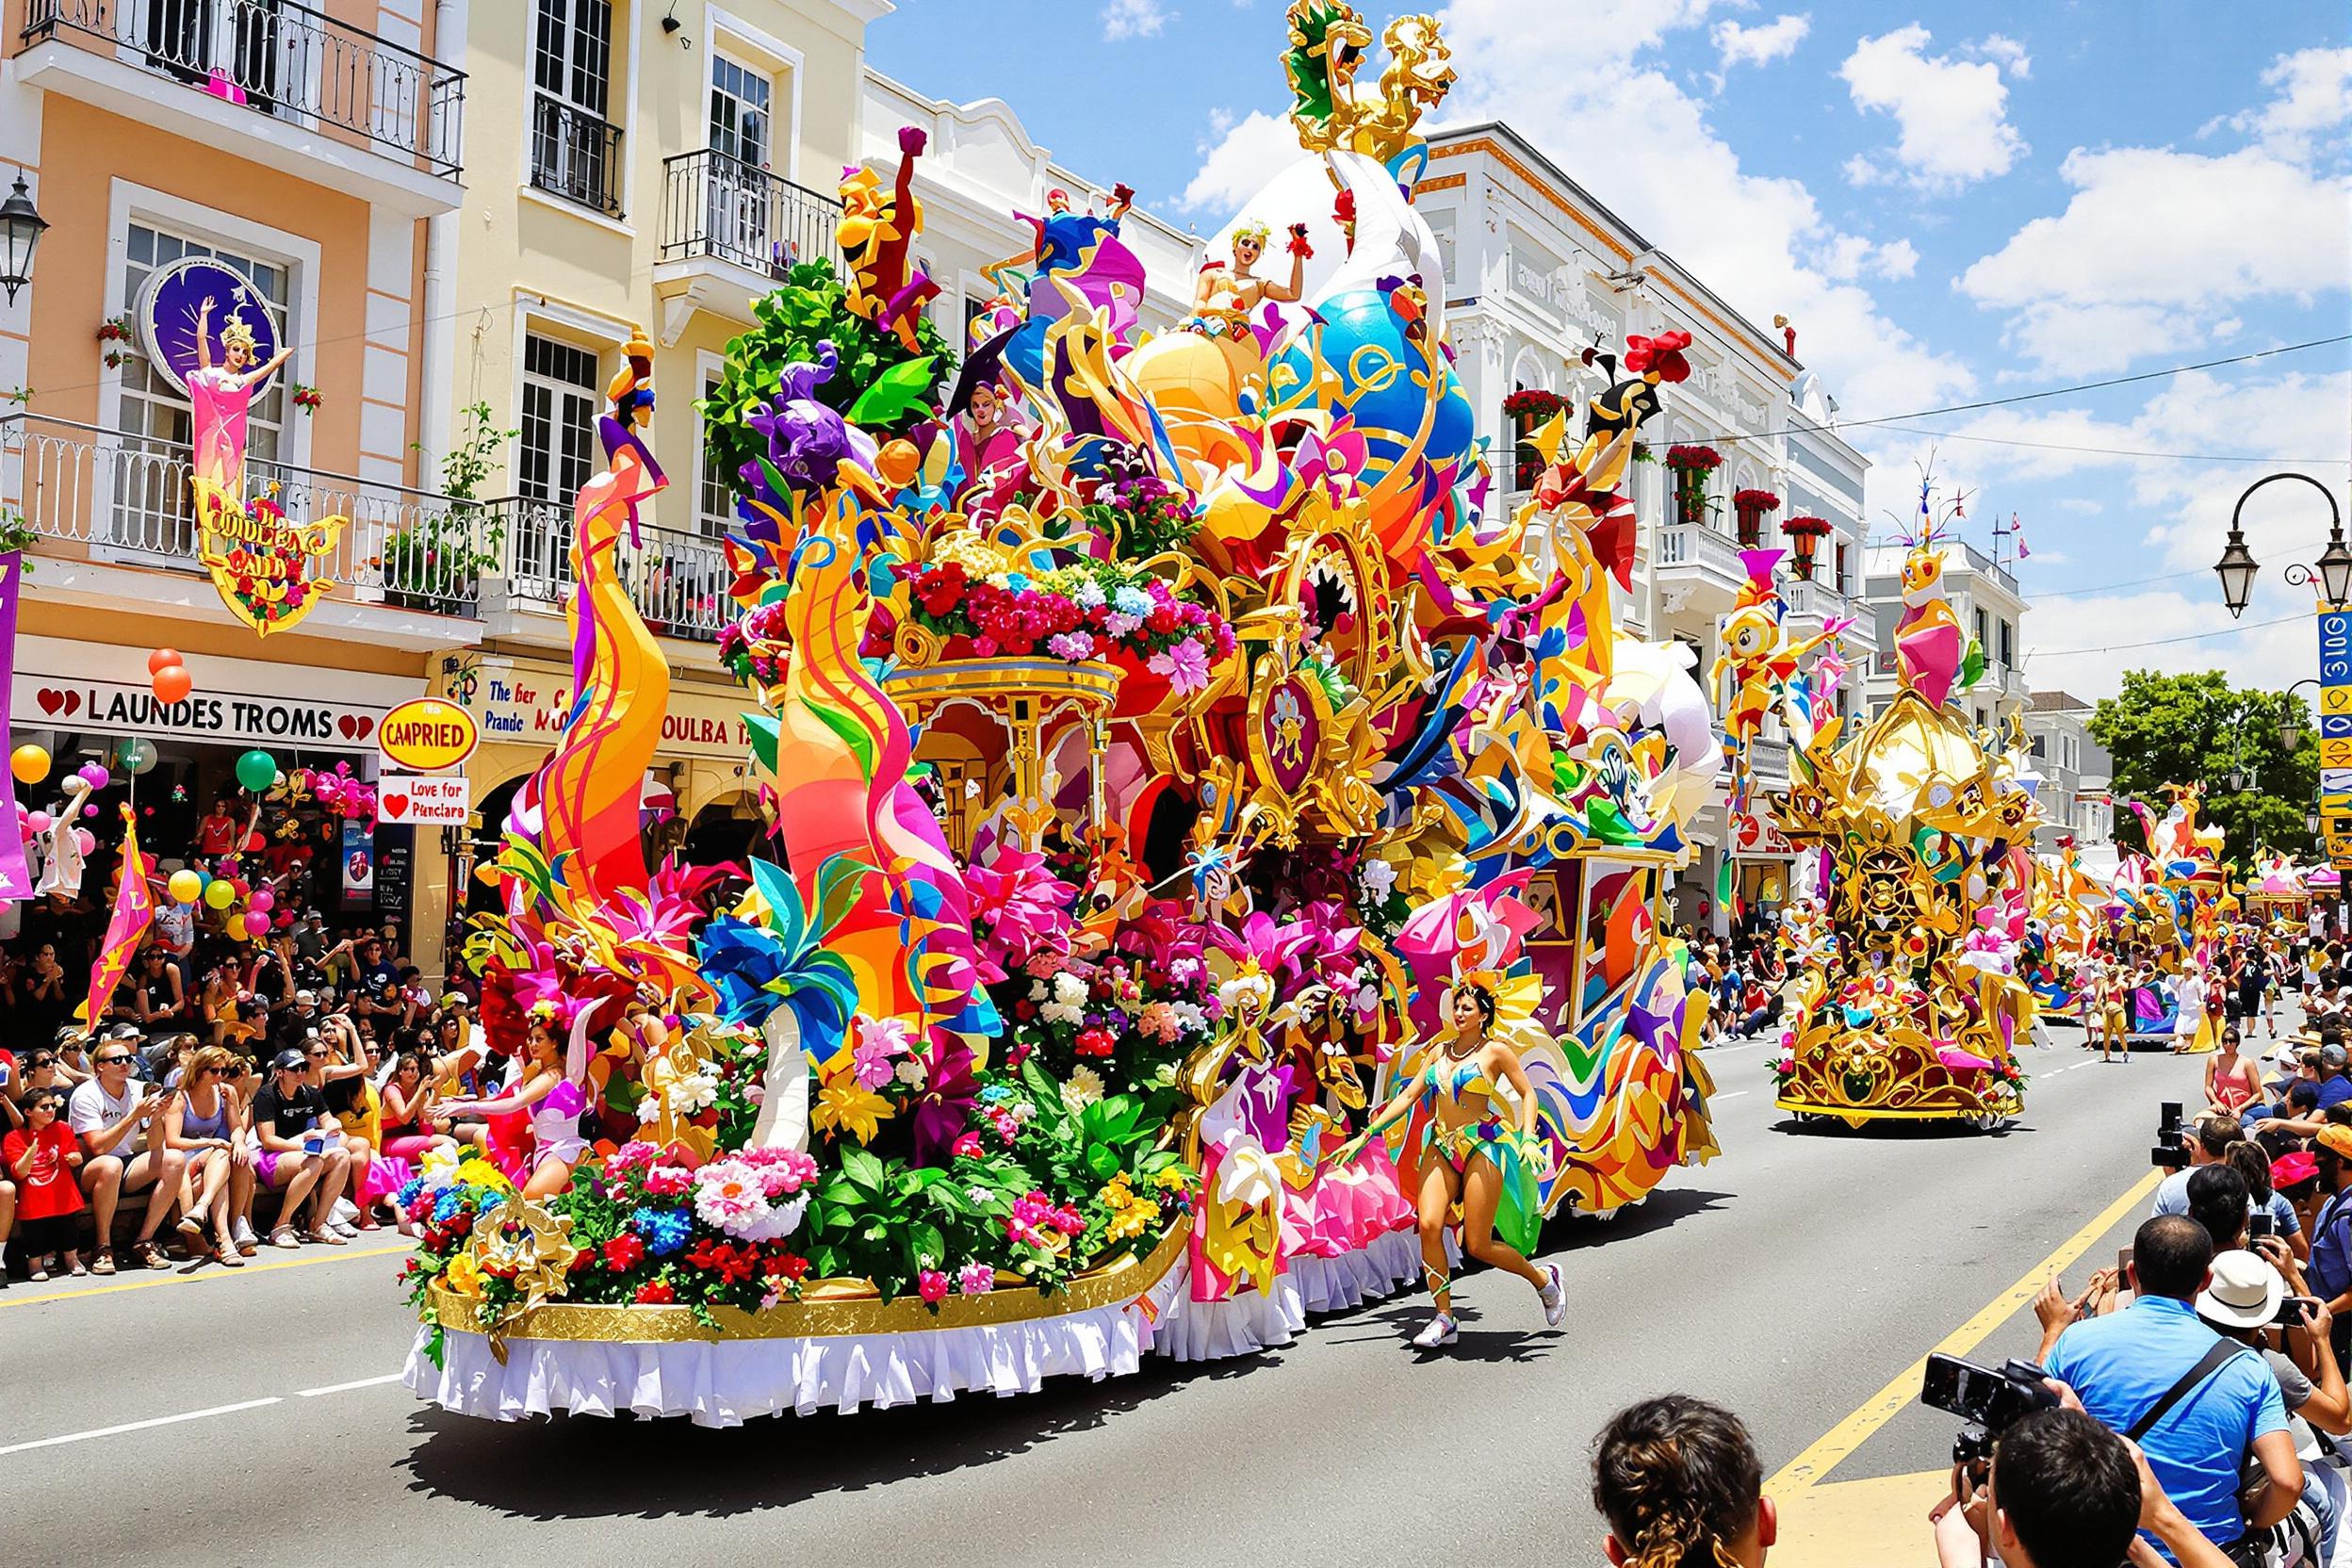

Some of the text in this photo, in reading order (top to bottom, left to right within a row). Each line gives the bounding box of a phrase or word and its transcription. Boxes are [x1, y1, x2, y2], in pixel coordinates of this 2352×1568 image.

[490, 680, 511, 702] The
[88, 689, 333, 739] LAUNDES TROMS
[411, 781, 437, 797] Love
